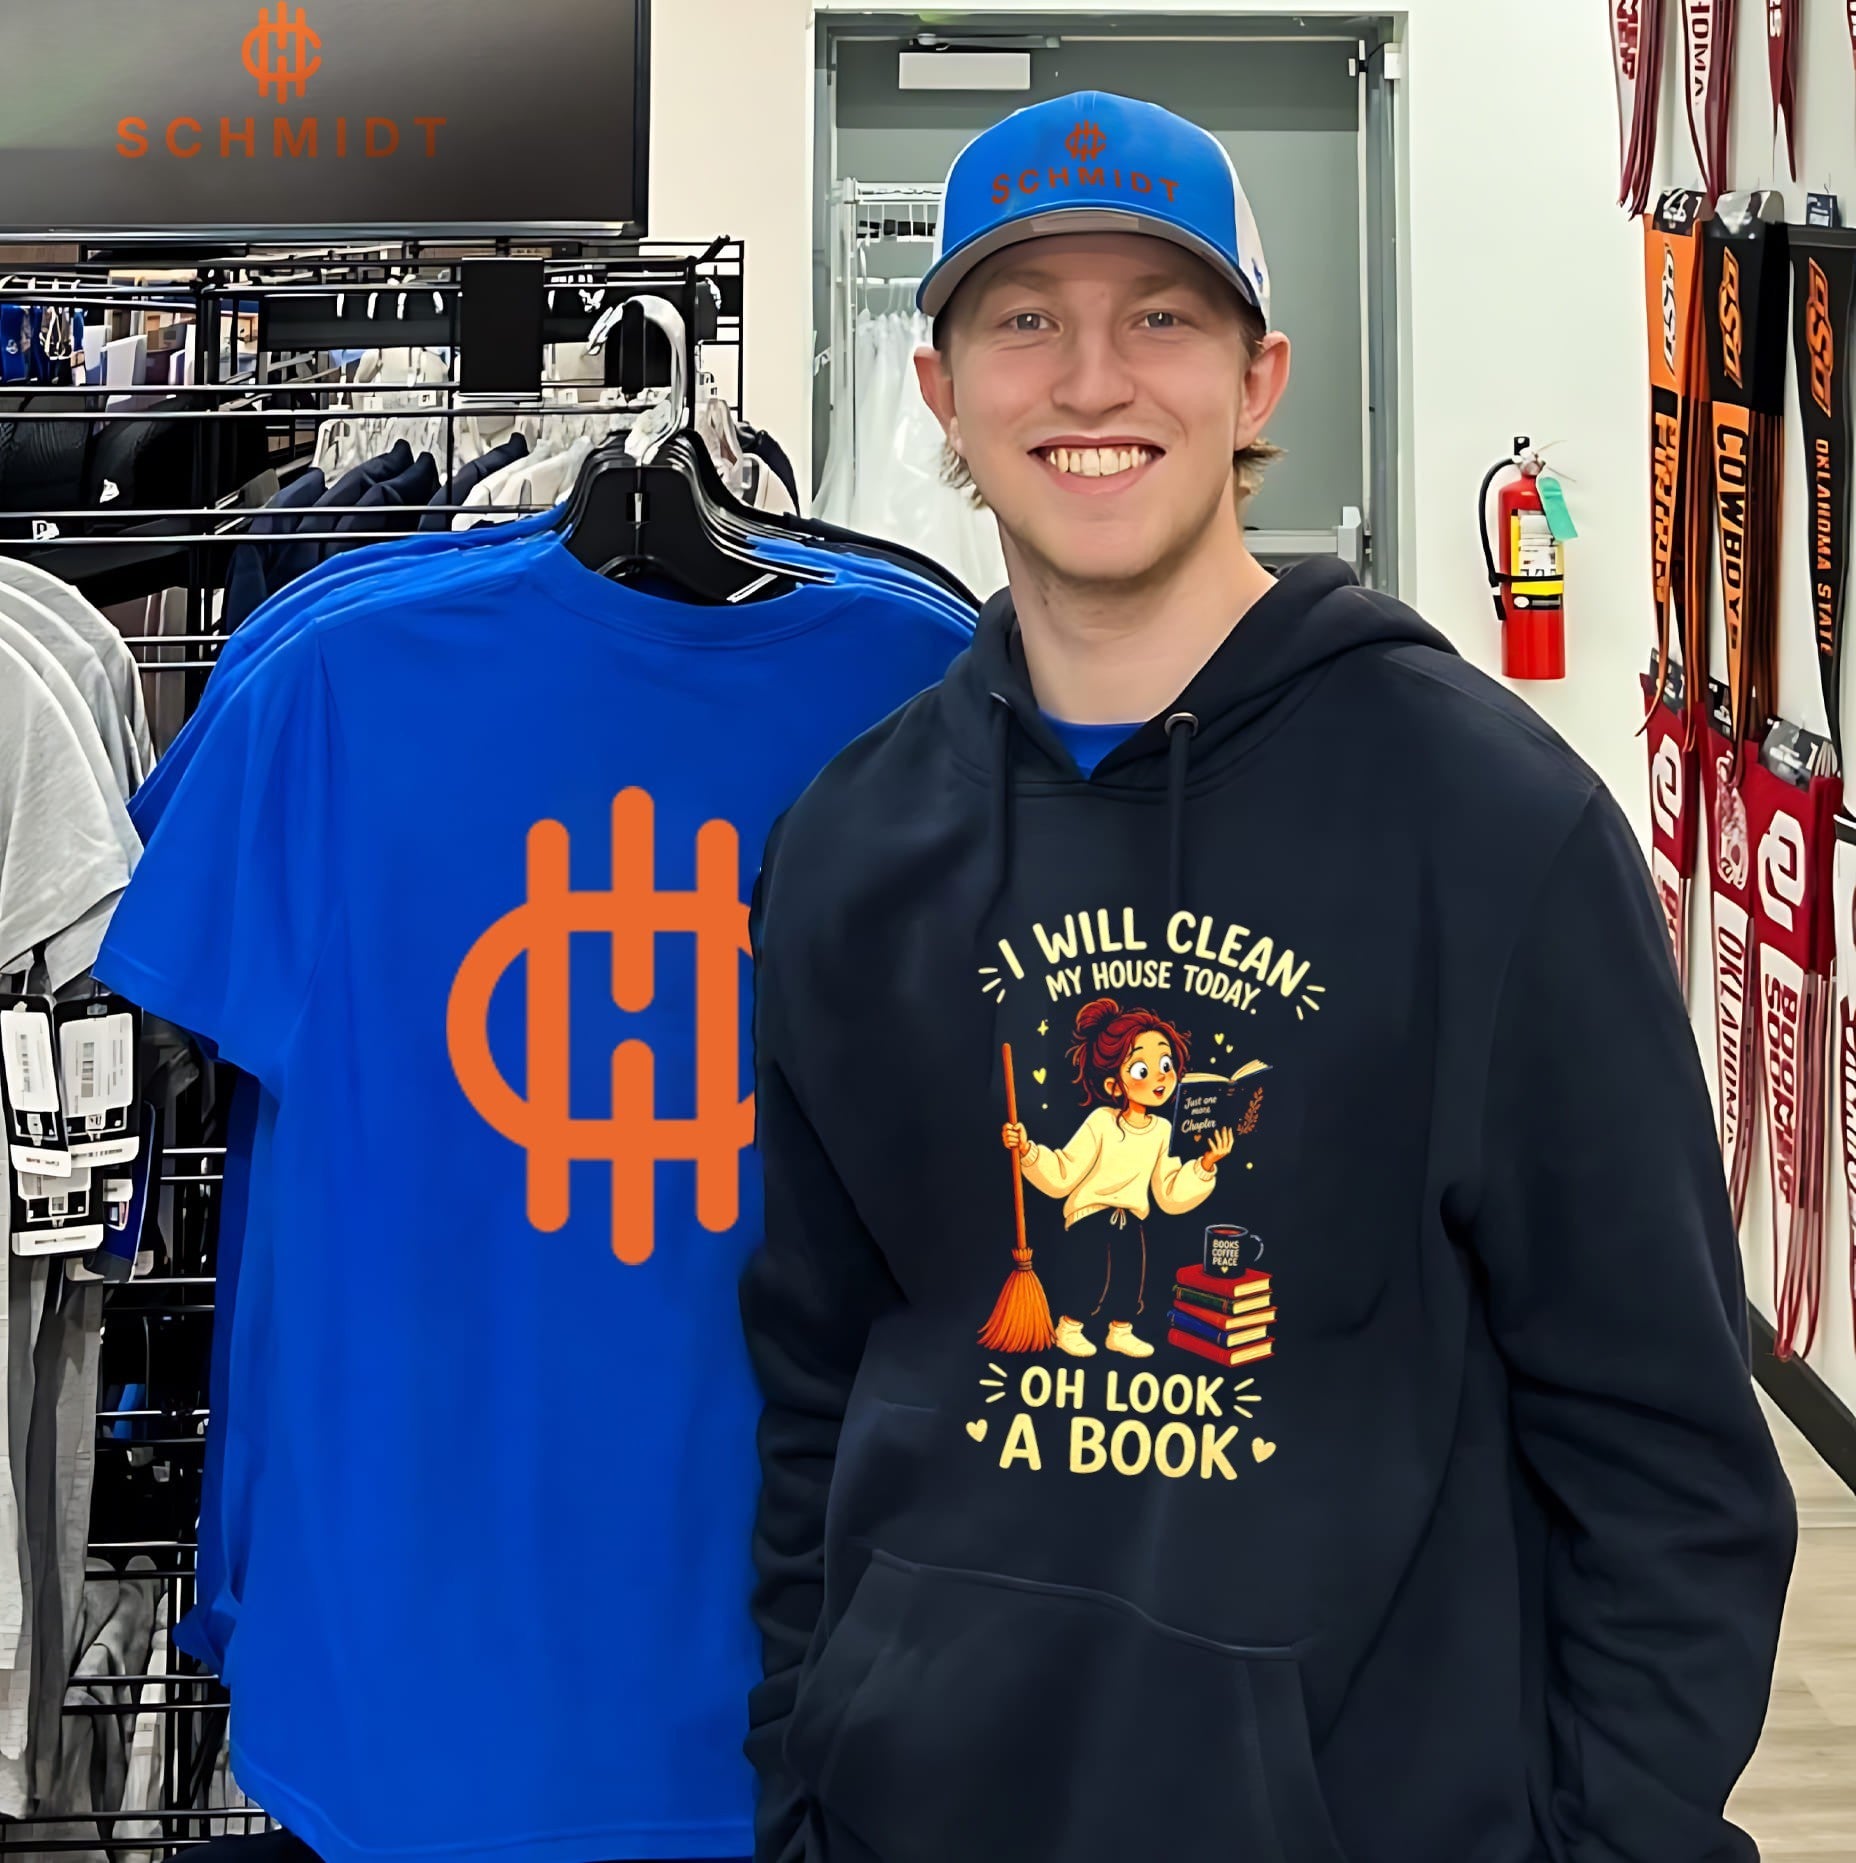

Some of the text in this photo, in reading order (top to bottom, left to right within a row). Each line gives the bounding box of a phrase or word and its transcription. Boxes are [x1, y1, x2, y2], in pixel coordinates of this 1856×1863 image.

[116, 116, 448, 160] SCHMIDT
[992, 167, 1179, 204] SCHMIDT
[1815, 438, 1832, 570] OKLAHOMA
[998, 906, 1311, 998] I WILL CLEAN
[1045, 959, 1262, 1015] MY HOUSE TODAY.
[1184, 1096, 1218, 1110] Just one
[1191, 1106, 1211, 1116] more
[1181, 1118, 1217, 1134] Chapter
[1211, 1248, 1240, 1258] COFFEE
[1212, 1239, 1240, 1249] BOOKS
[1212, 1257, 1239, 1266] PEACE
[1020, 1365, 1225, 1417] OH LOOK
[999, 1412, 1240, 1481] A BOOK
